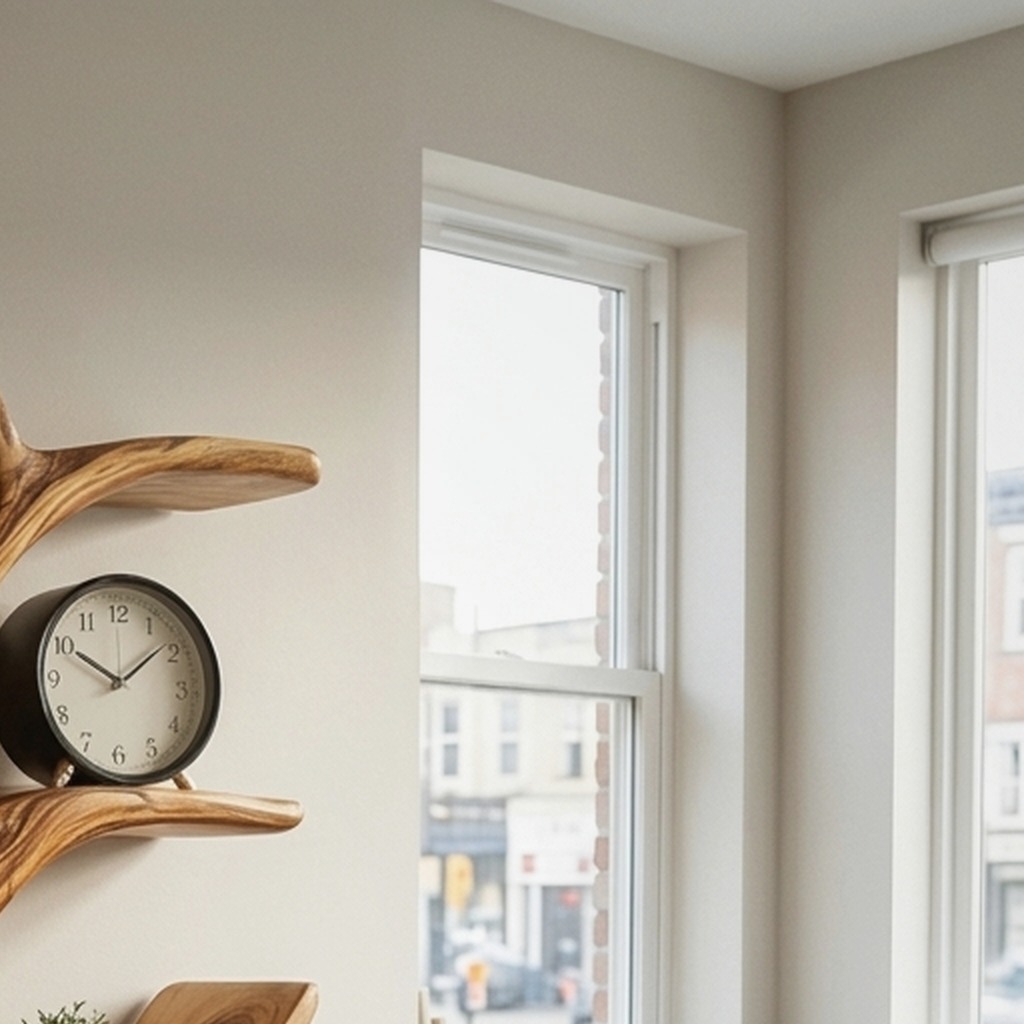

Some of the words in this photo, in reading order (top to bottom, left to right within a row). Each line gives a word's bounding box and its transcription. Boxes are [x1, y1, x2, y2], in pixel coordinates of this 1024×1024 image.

[79, 612, 94, 632] 11
[109, 605, 129, 623] 12
[145, 617, 153, 635] 1
[54, 636, 74, 655] 10
[167, 643, 179, 663] 2
[47, 669, 60, 689] 9
[176, 681, 188, 700] 3
[56, 705, 69, 725] 8
[168, 715, 179, 733] 4
[80, 732, 92, 753] 7
[145, 737, 158, 758] 5
[112, 745, 126, 765] 6
